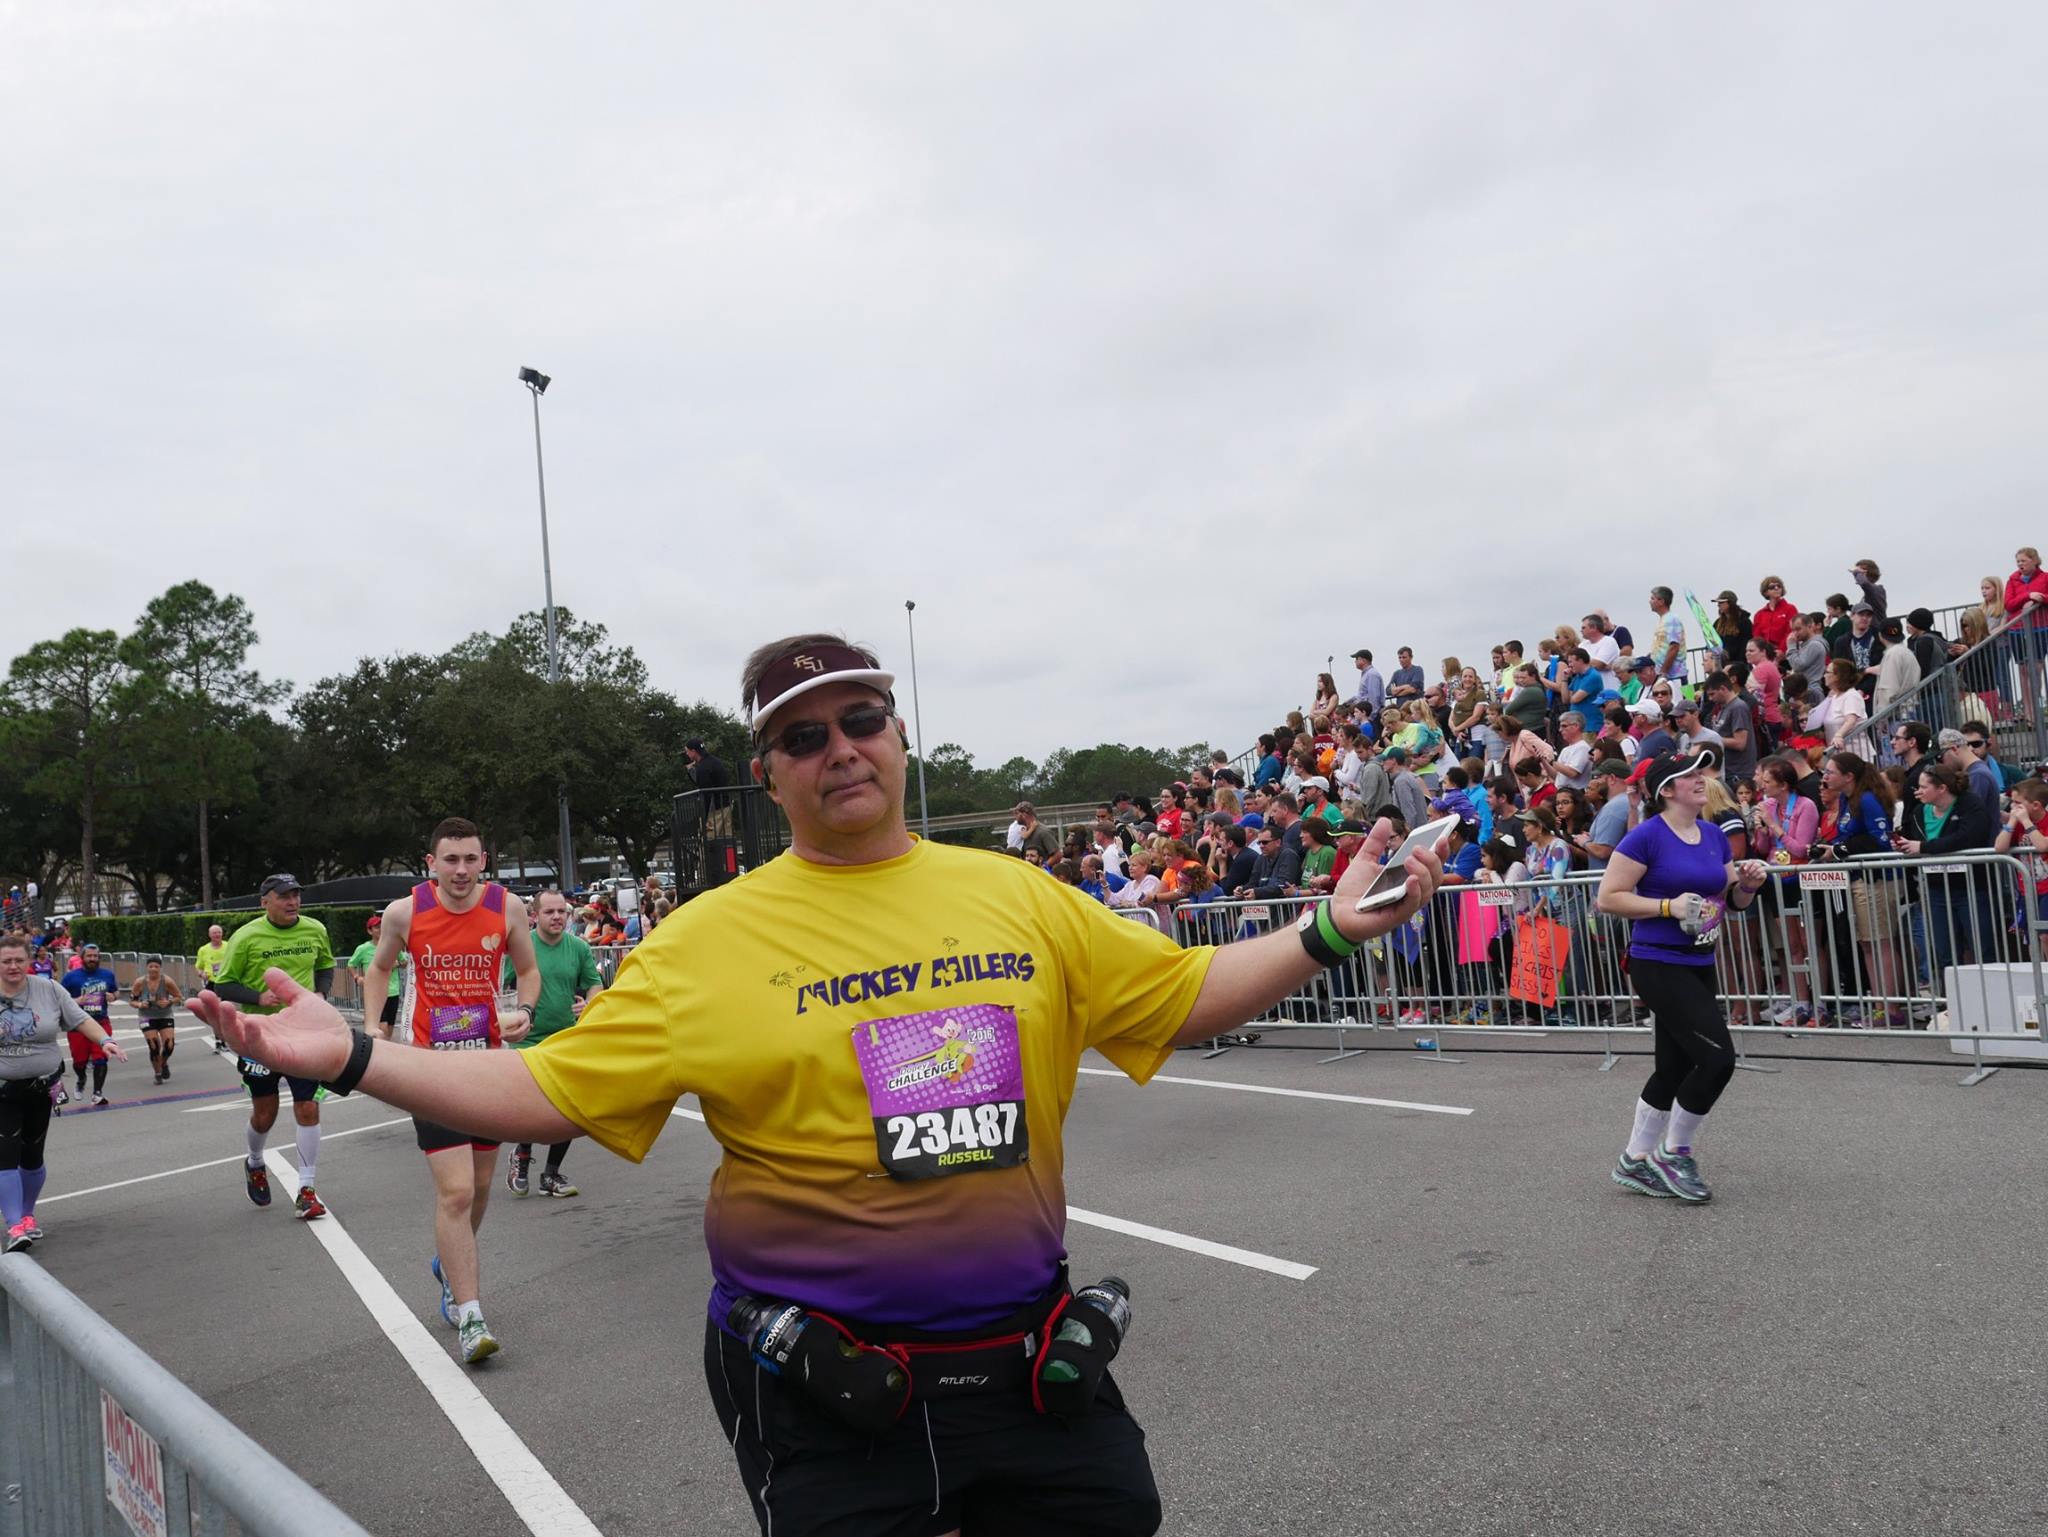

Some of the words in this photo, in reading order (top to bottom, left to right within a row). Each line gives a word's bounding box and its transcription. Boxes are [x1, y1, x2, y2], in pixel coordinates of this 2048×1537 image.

[793, 655, 824, 672] FSU
[1801, 872, 1847, 881] NATIONAL
[1480, 890, 1512, 898] NATIONAL
[421, 944, 492, 968] dreams
[424, 970, 461, 981] come
[464, 967, 490, 981] true
[797, 963, 922, 1016] MICKEY
[931, 953, 1035, 989] MILERS
[970, 1028, 993, 1043] 2016
[888, 1059, 957, 1090] CHALLENGE
[887, 1103, 1018, 1161] 23487
[938, 1149, 994, 1166] RUSSELL
[106, 1393, 162, 1509] NATIONAL
